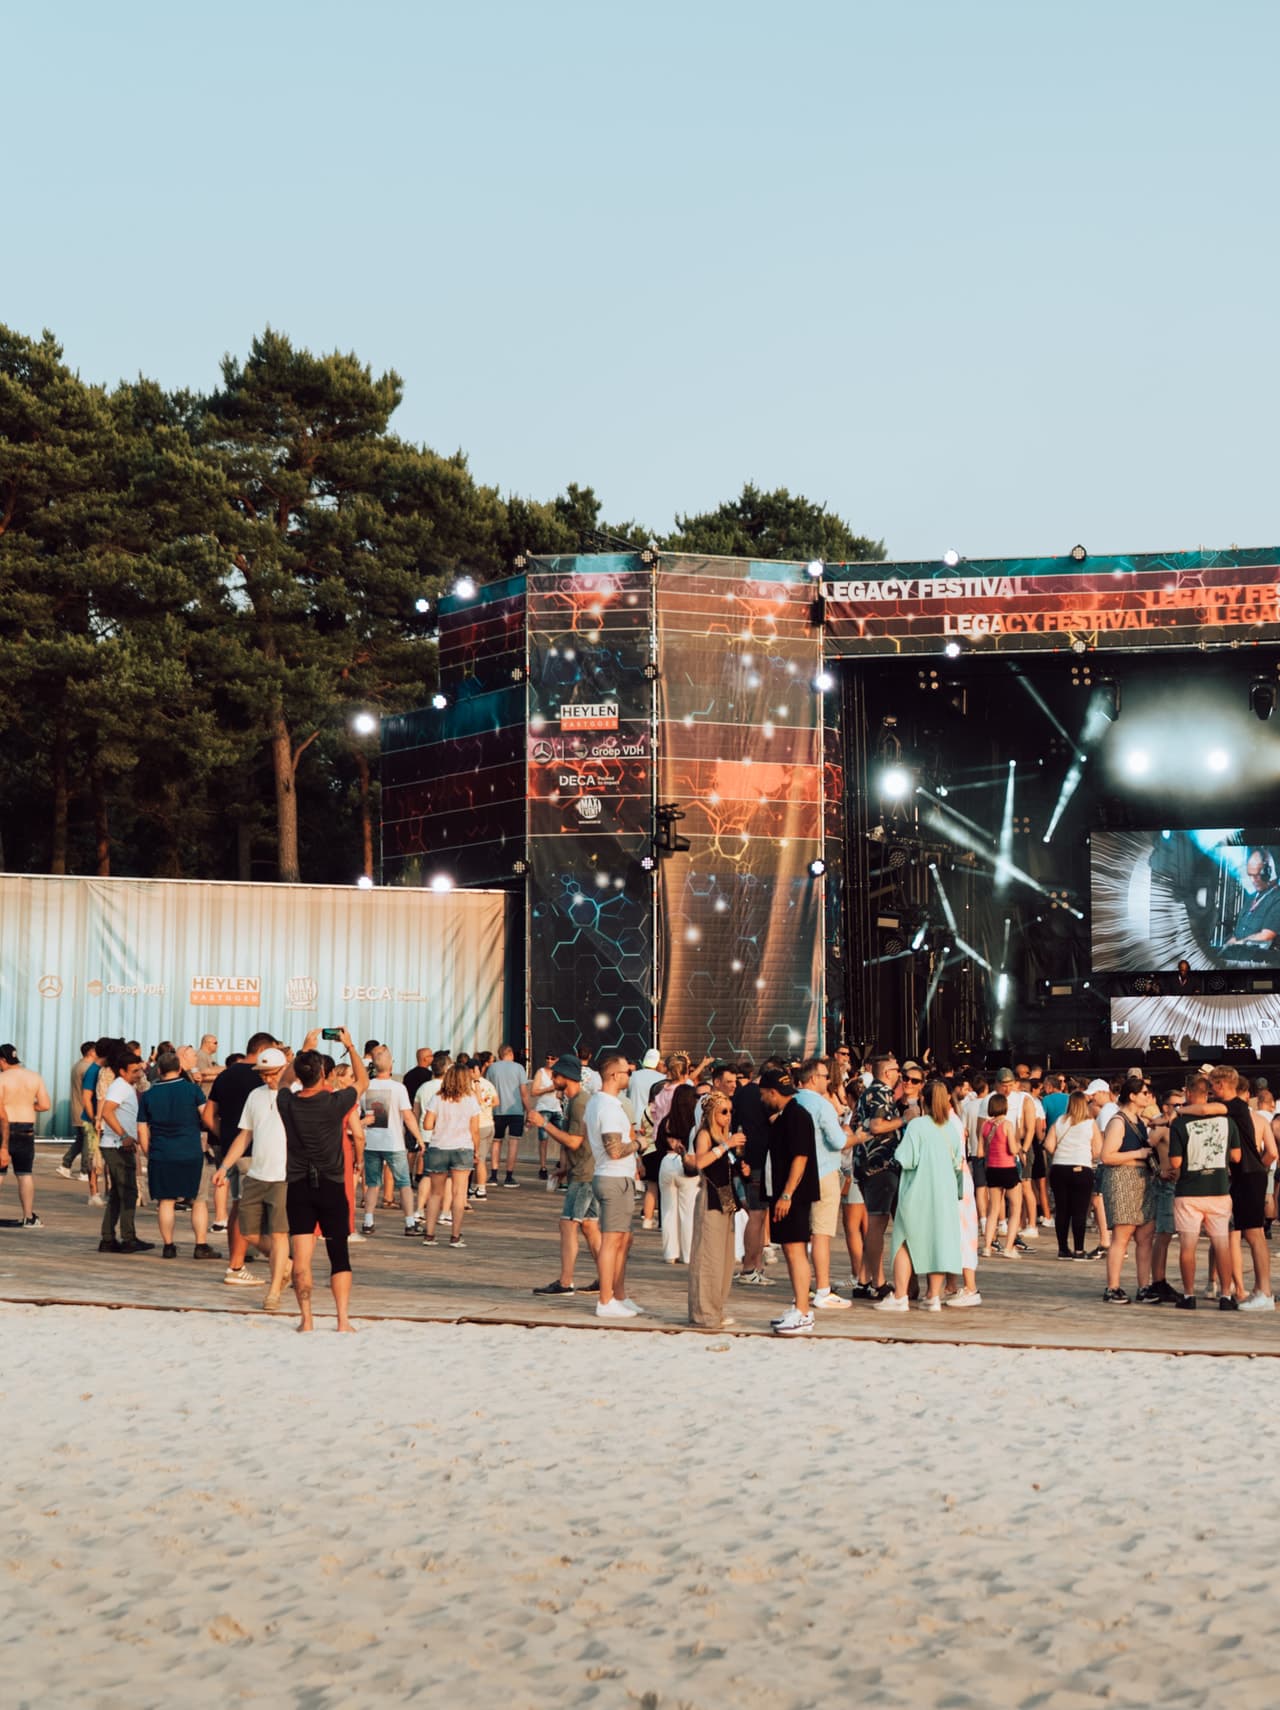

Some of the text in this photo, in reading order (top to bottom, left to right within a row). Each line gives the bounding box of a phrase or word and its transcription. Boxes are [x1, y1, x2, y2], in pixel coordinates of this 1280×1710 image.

[823, 577, 1028, 601] LEGACY FESTIVAL
[1145, 586, 1240, 608] LEGACY
[944, 610, 1154, 634] LEGACY FESTIVAL
[562, 705, 617, 717] HEYLEN
[591, 745, 644, 757] Groep VDH
[559, 775, 596, 786] DECA
[581, 797, 599, 808] MAX
[193, 977, 257, 990] HEYLEN
[343, 986, 392, 1001] DECA
